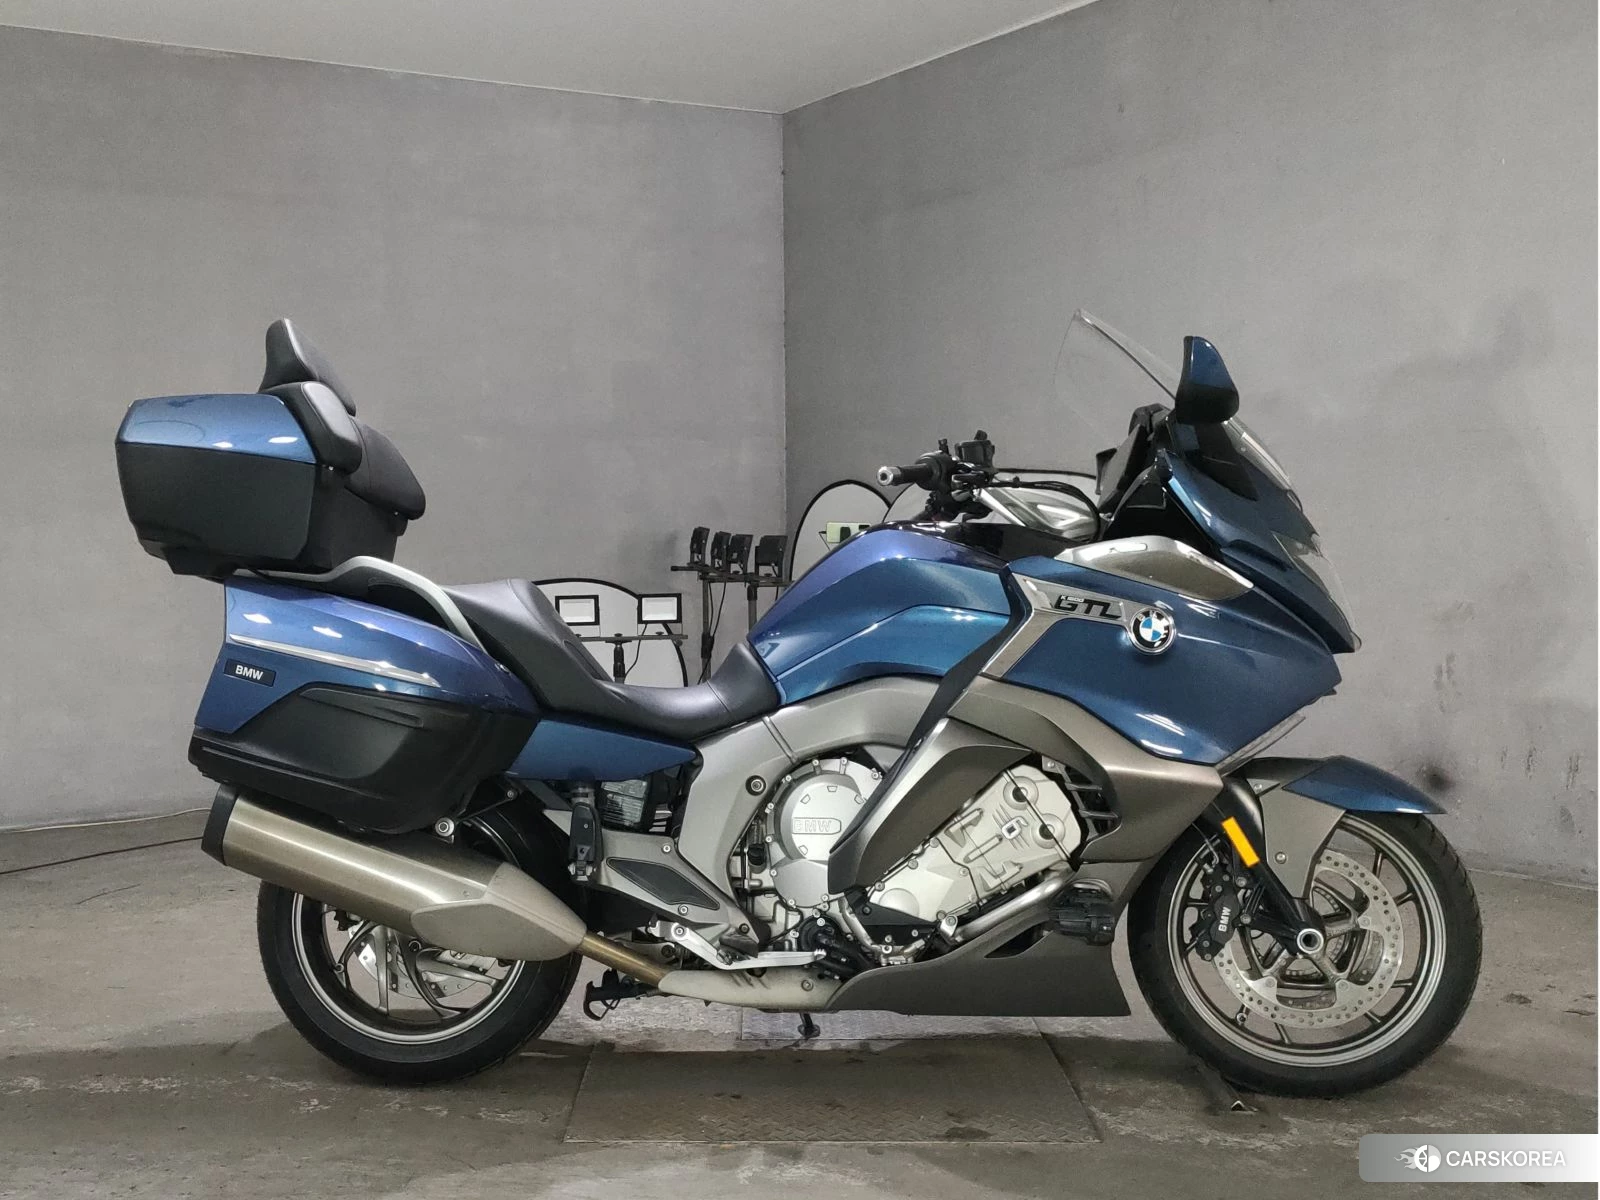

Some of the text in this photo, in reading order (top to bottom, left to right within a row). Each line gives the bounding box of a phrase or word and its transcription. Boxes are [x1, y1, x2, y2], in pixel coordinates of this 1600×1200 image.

[1054, 595, 1121, 618] GTL
[235, 664, 264, 680] BMW
[793, 820, 832, 832] BMW
[1218, 906, 1231, 932] BMW
